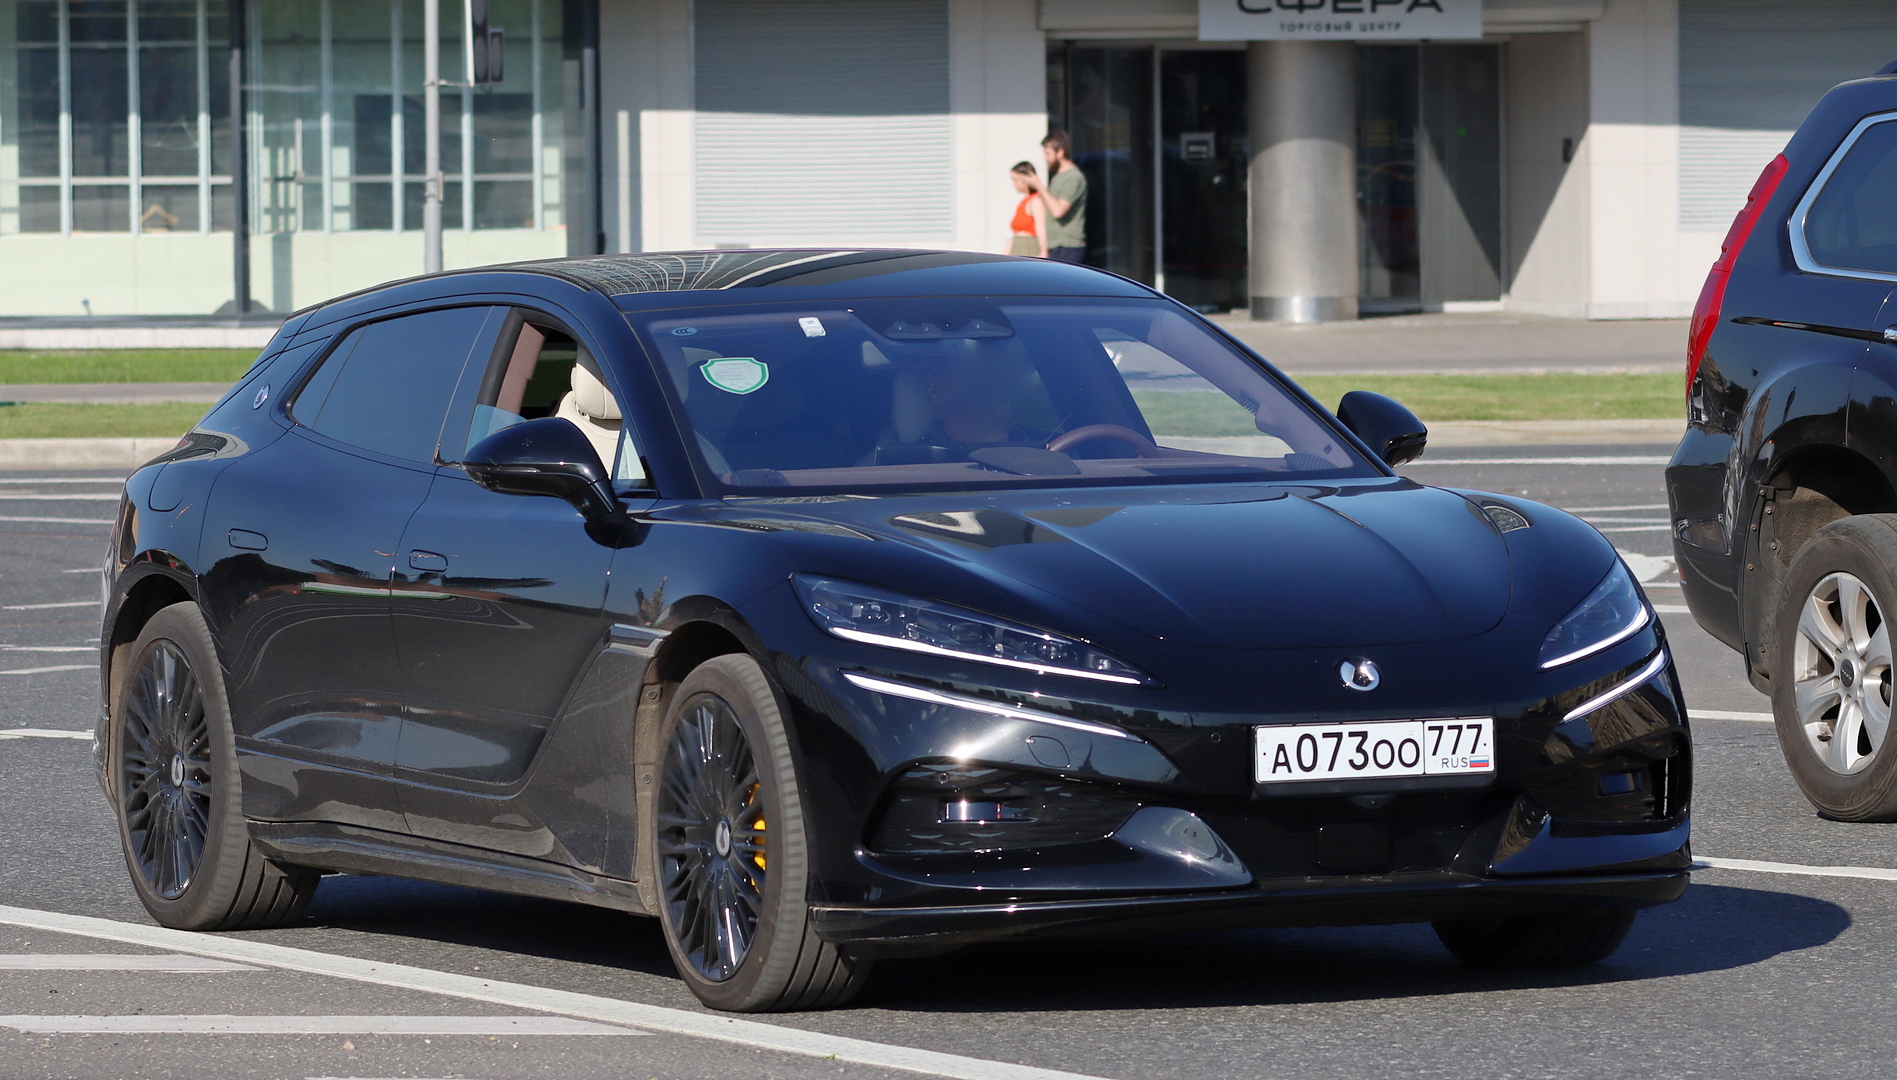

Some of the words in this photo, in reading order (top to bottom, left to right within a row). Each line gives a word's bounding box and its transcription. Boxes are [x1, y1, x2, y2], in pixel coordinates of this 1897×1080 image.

[1279, 21, 1353, 33] ТОРГОВЫЙ
[1359, 22, 1402, 33] ЦЕНТР
[1427, 723, 1483, 756] 777
[1441, 757, 1469, 769] RUS
